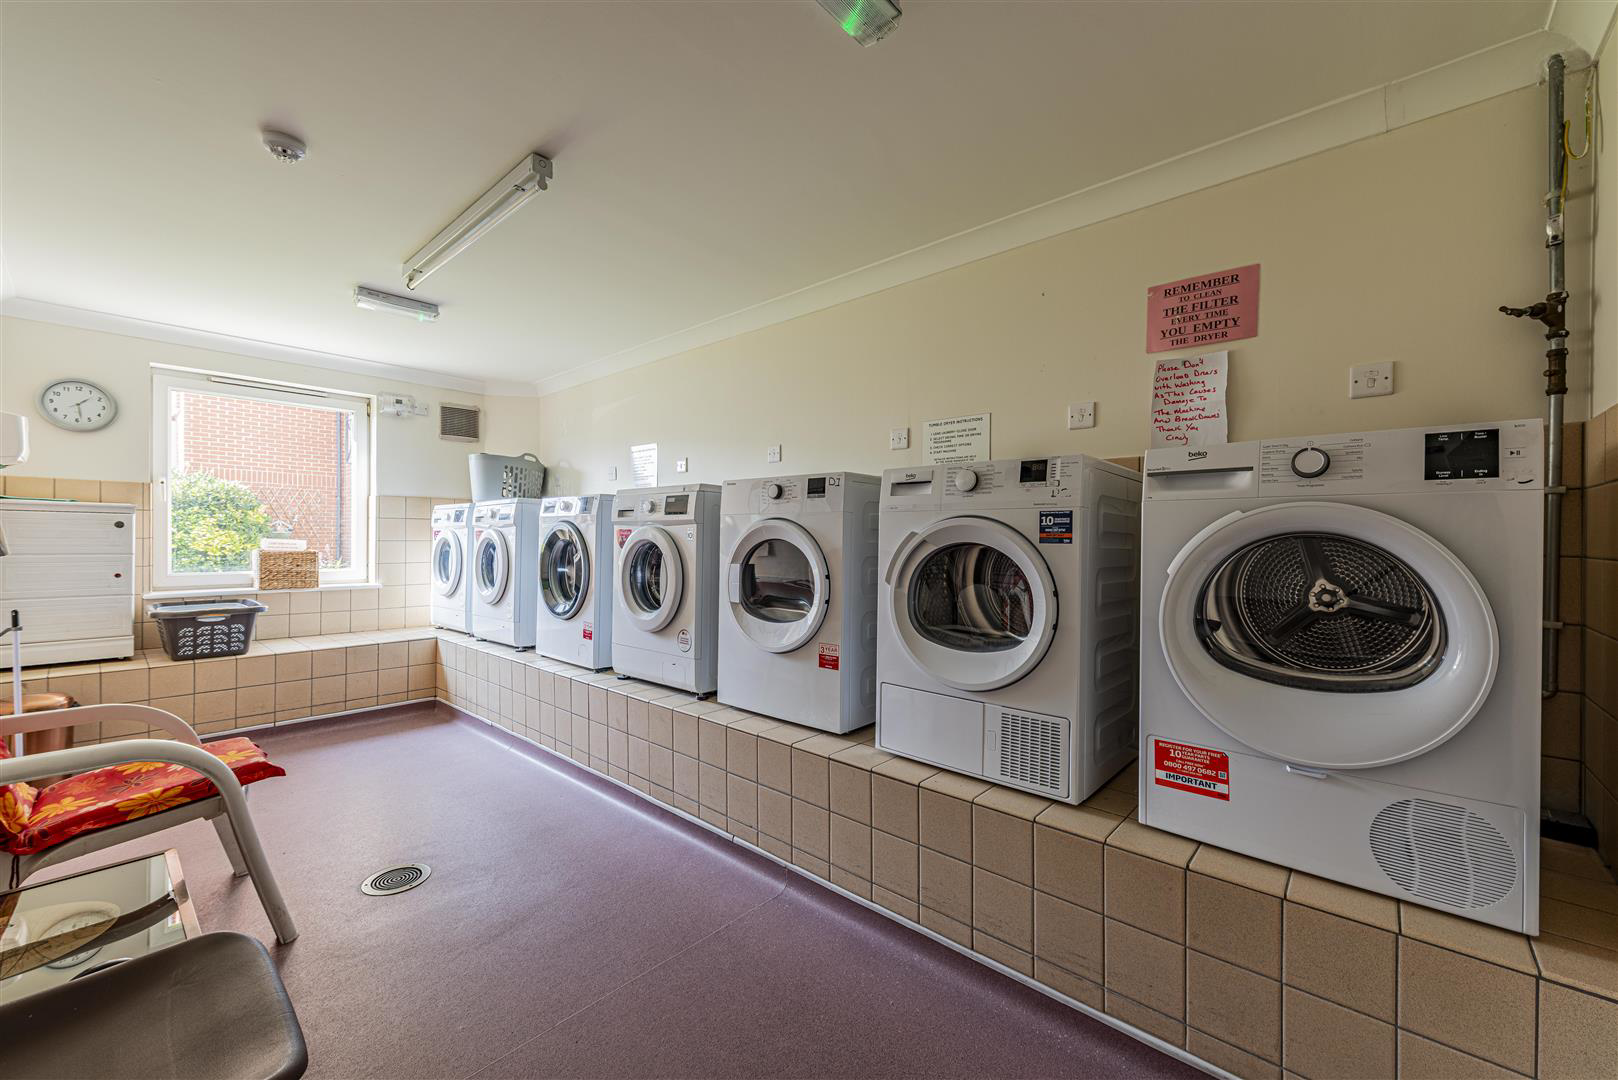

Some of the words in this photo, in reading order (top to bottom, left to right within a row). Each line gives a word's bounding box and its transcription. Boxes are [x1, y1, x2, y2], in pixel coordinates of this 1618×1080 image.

[1164, 274, 1240, 298] REMEMBER
[1179, 295, 1190, 303] TO
[1194, 289, 1222, 300] CLEAN
[1162, 304, 1188, 318] THE
[1192, 295, 1238, 311] FILTER
[1171, 314, 1200, 325] EVERY
[1206, 308, 1228, 318] TIME
[1160, 326, 1186, 338] YOU
[1193, 317, 1240, 333] EMPTY
[1170, 336, 1189, 346] THE
[1194, 331, 1228, 343] DRYER
[1158, 364, 1179, 373] Please
[1164, 398, 1194, 406] Damage
[1186, 423, 1198, 432] You
[1041, 516, 1054, 525] 10
[1158, 742, 1182, 750] REGISTER
[1169, 749, 1182, 758] 10
[1181, 755, 1210, 764] GUARANTEE
[1164, 760, 1182, 769] 0800
[1197, 768, 1217, 776] 0682
[1165, 772, 1218, 790] IMPORTANT
